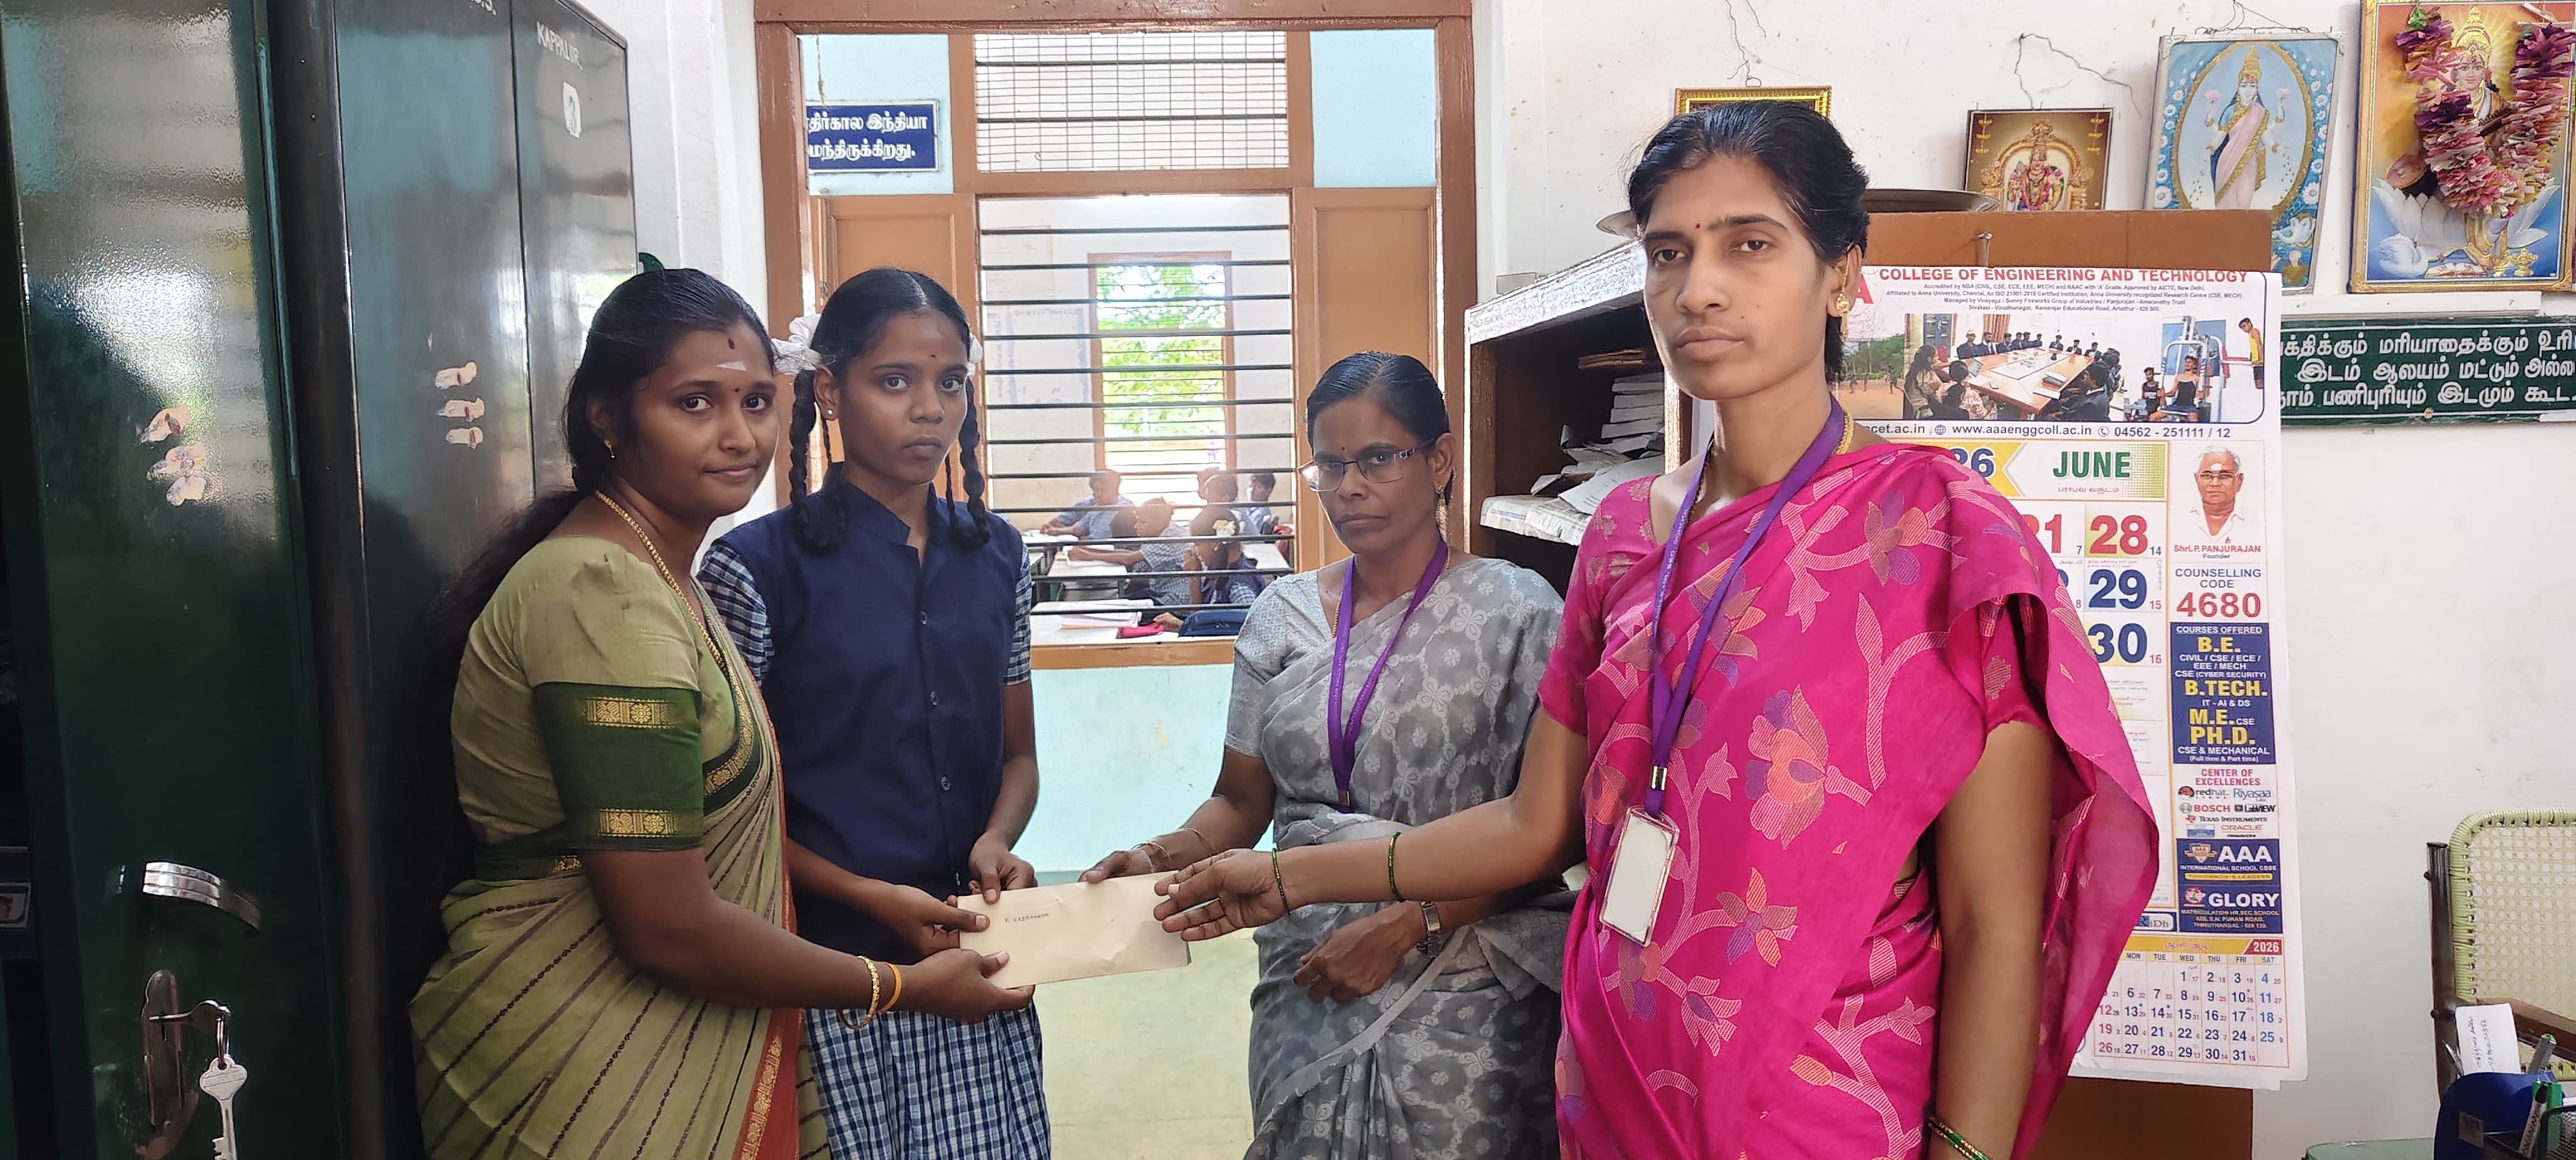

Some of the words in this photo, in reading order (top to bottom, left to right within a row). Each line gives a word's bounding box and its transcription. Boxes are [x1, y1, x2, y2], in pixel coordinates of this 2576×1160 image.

[806, 111, 863, 134] திர்கால
[867, 110, 928, 133] இந்தியா
[1879, 269, 1953, 281] COLLEGE
[1958, 269, 1979, 281] OF
[1985, 269, 2096, 282] ENGINEERING
[2101, 269, 2134, 282] AND
[2139, 270, 2247, 282] TECHNOLOGY
[2280, 332, 2368, 361] க்திக்கும்
[2379, 330, 2529, 357] மரியாதைக்கும்
[2296, 357, 2361, 382] இடம்
[2373, 355, 2450, 384] ஆலயம்
[2459, 354, 2519, 382] மட்டும்
[2323, 382, 2426, 409] பணிபுரியும்
[2438, 380, 2514, 408] இடமும்
[1952, 425, 2092, 437] www.aaaenggcoll.ac.in
[2114, 427, 2151, 437] 04562
[2163, 427, 2203, 437] 251111
[2217, 428, 2231, 438] 12
[2053, 452, 2131, 478] JUNE
[2076, 545, 2082, 555] 7
[2089, 515, 2148, 555] 28
[2150, 547, 2162, 555] 14
[2175, 569, 2262, 577] COUNSELLING
[2075, 600, 2082, 609] 8
[2089, 569, 2147, 609] 29
[2150, 601, 2162, 610] 15
[2200, 579, 2235, 588] CODE
[2177, 592, 2261, 618] 4680
[2087, 623, 2147, 664] 30
[2150, 655, 2162, 664] 16
[2197, 637, 2241, 653] B.E.
[2185, 680, 2267, 696] B.TECH.
[2189, 708, 2235, 725] M.E.
[2190, 726, 2256, 745] PH.D.
[2202, 769, 2238, 777] CENTER
[2196, 778, 2260, 786] EXCELLENCES
[2233, 788, 2271, 800] Riyasaa
[2218, 845, 2273, 862] AAA
[2208, 893, 2280, 908] GLORY
[2253, 941, 2279, 952] 2026
[2180, 971, 2185, 981] 1
[2207, 972, 2214, 982] 2
[2234, 973, 2241, 983] 3
[2261, 973, 2268, 983] 4
[2127, 988, 2134, 998] 6
[2153, 989, 2161, 999] 7
[2180, 990, 2187, 1000] 8
[2207, 991, 2214, 1001] 9
[2232, 992, 2245, 1003] 10
[2259, 993, 2271, 1003] 11
[2100, 1005, 2112, 1015] 12
[2124, 1007, 2138, 1017] 13
[2151, 1008, 2165, 1018] 14
[2178, 1009, 2192, 1019] 15
[2205, 1010, 2219, 1020] 16
[2232, 1011, 2246, 1022] 17
[2260, 1012, 2274, 1022] 18
[2099, 1023, 2112, 1034] 19
[2124, 1025, 2139, 1035] 20
[2151, 1026, 2163, 1037] 21
[2178, 1028, 2192, 1039] 22
[2205, 1029, 2219, 1040] 23
[2232, 1030, 2246, 1041] 24
[2260, 1032, 2274, 1042] 25
[2099, 1042, 2112, 1052] 26
[2124, 1044, 2138, 1054] 27
[2151, 1046, 2165, 1056] 28
[2178, 1047, 2192, 1057] 29
[2205, 1048, 2219, 1059] 30
[2233, 1050, 2246, 1061] 31
